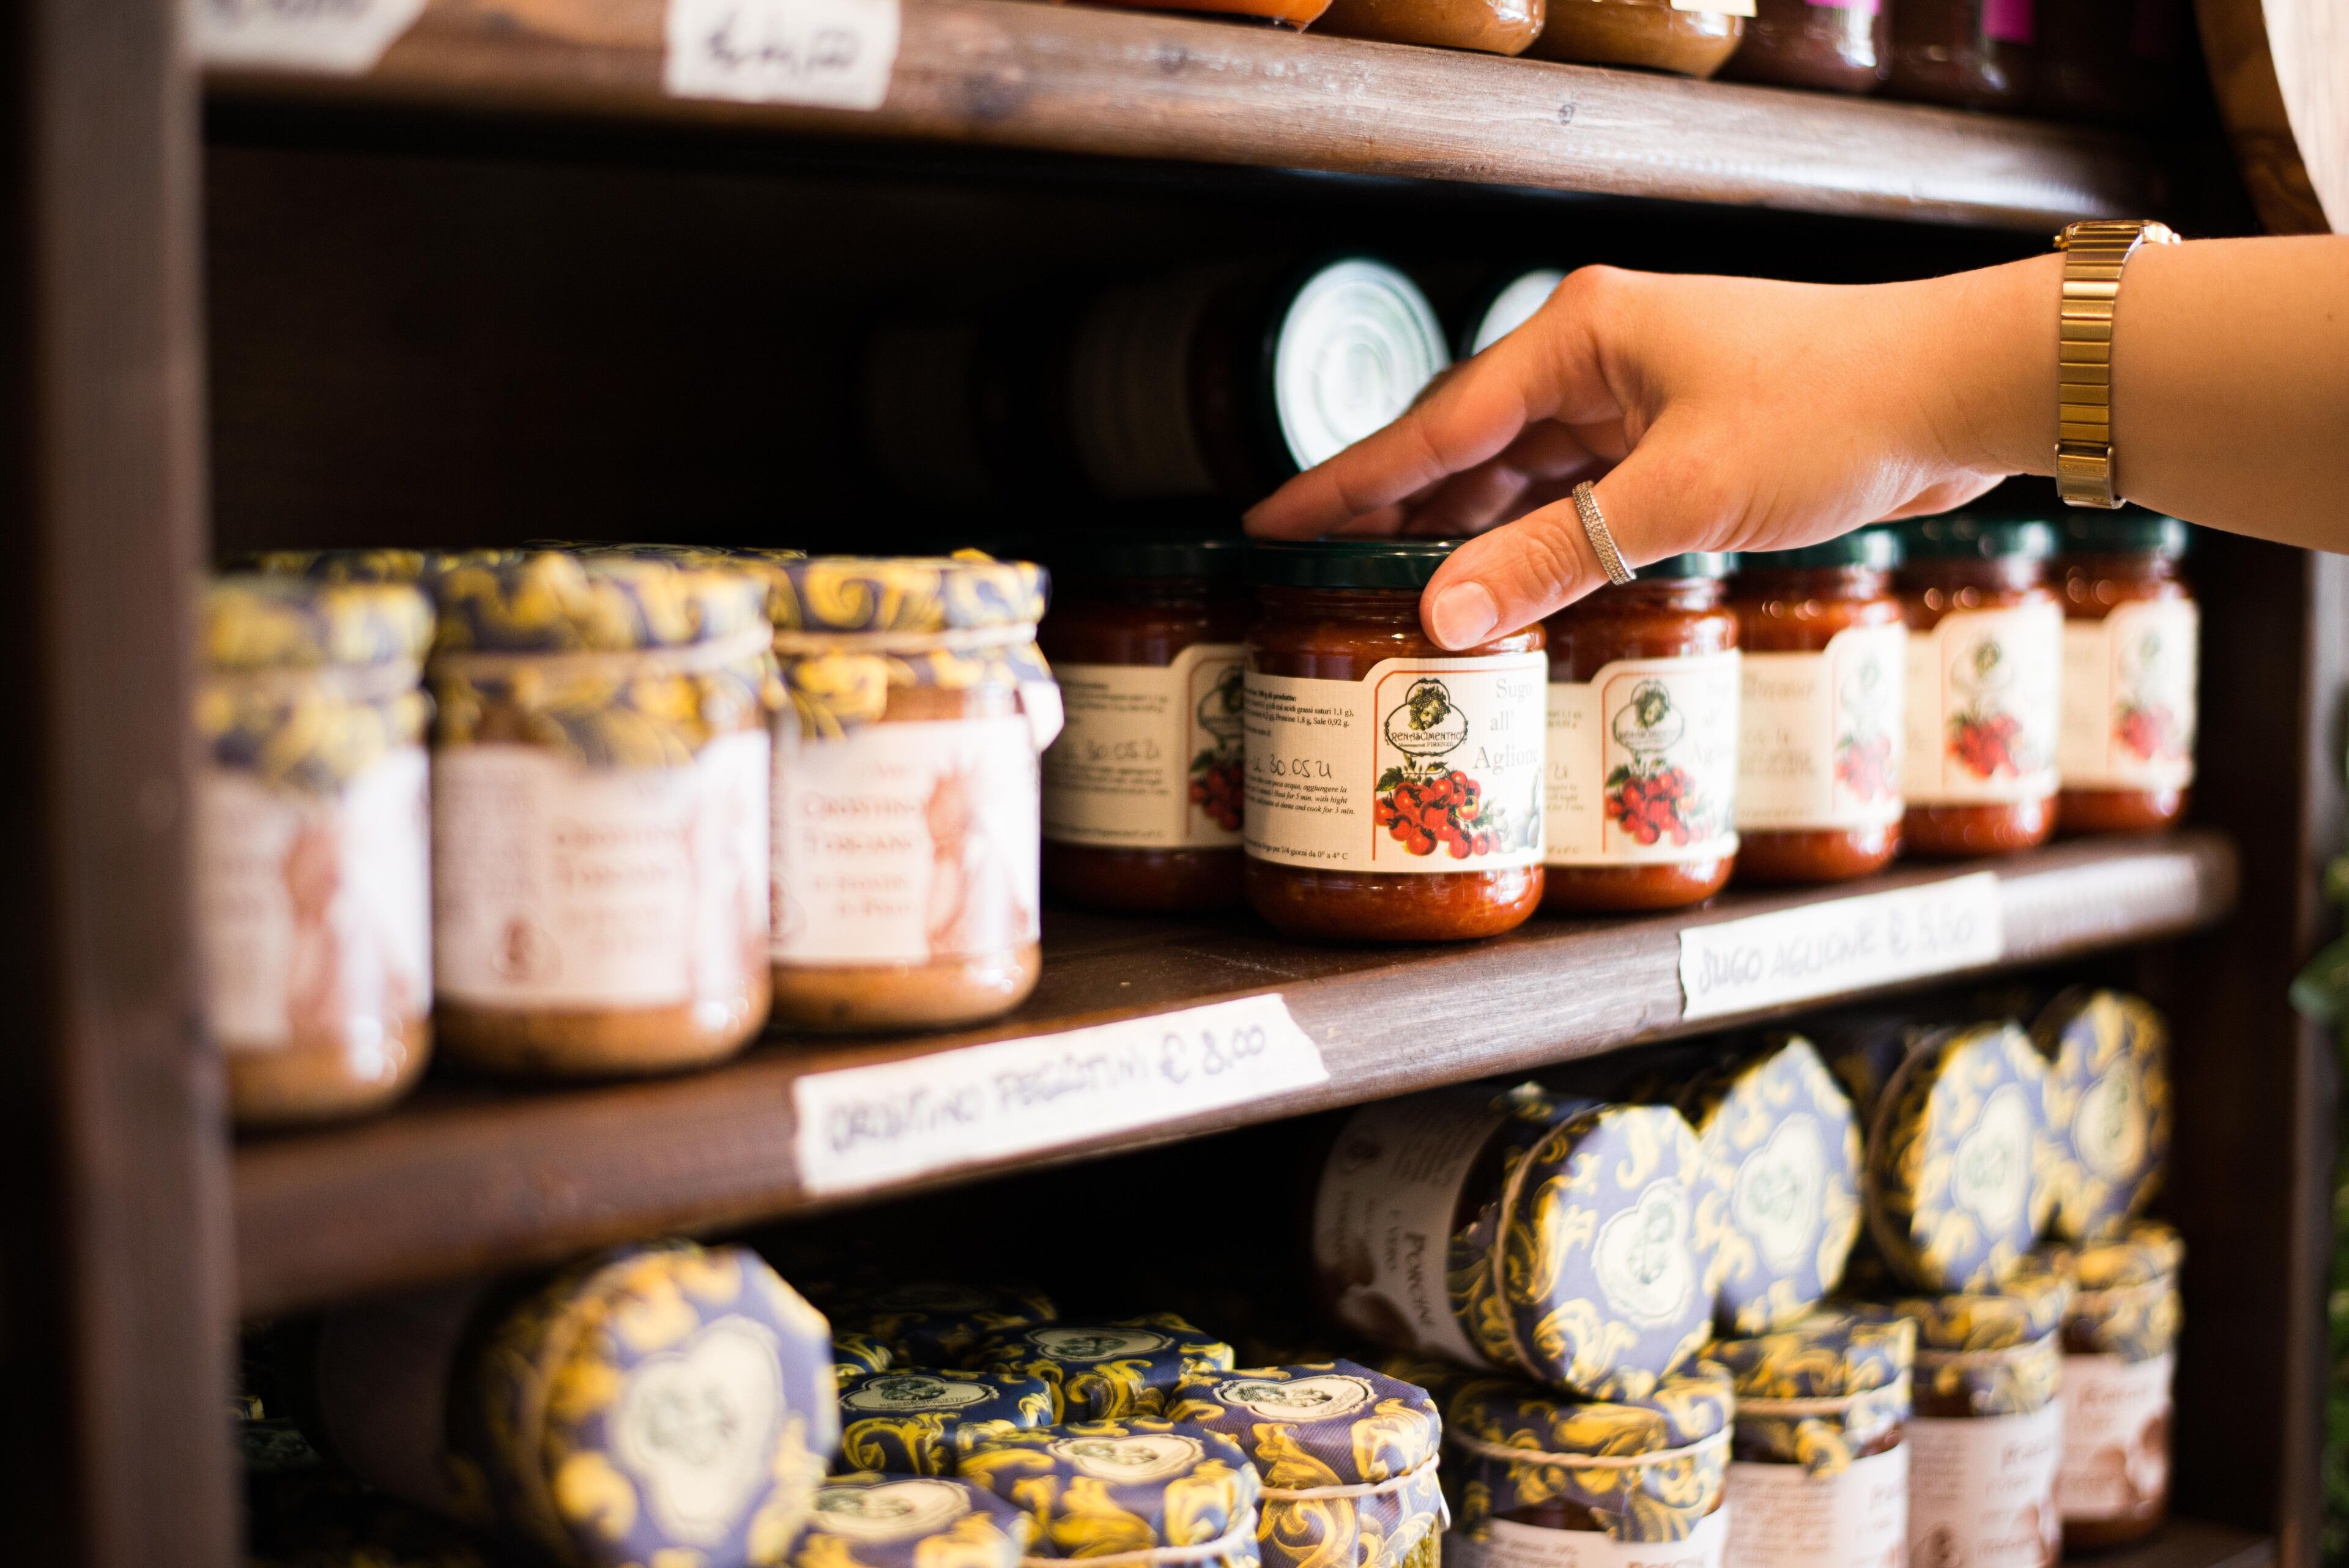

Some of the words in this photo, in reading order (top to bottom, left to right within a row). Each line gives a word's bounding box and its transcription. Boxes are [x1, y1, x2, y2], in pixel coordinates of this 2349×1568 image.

[1496, 678, 1532, 703] Sugo
[1273, 693, 1296, 702] prodotto:
[1297, 706, 1313, 715] grassi
[1276, 713, 1295, 723] Proteine
[1327, 718, 1341, 727] 0,92
[1303, 784, 1338, 793] aggiungere
[1286, 791, 1294, 800] for
[1330, 796, 1348, 805] hight
[1280, 801, 1294, 810] dente
[1160, 1032, 1189, 1084] €
[1200, 1024, 1266, 1077] 8,00
